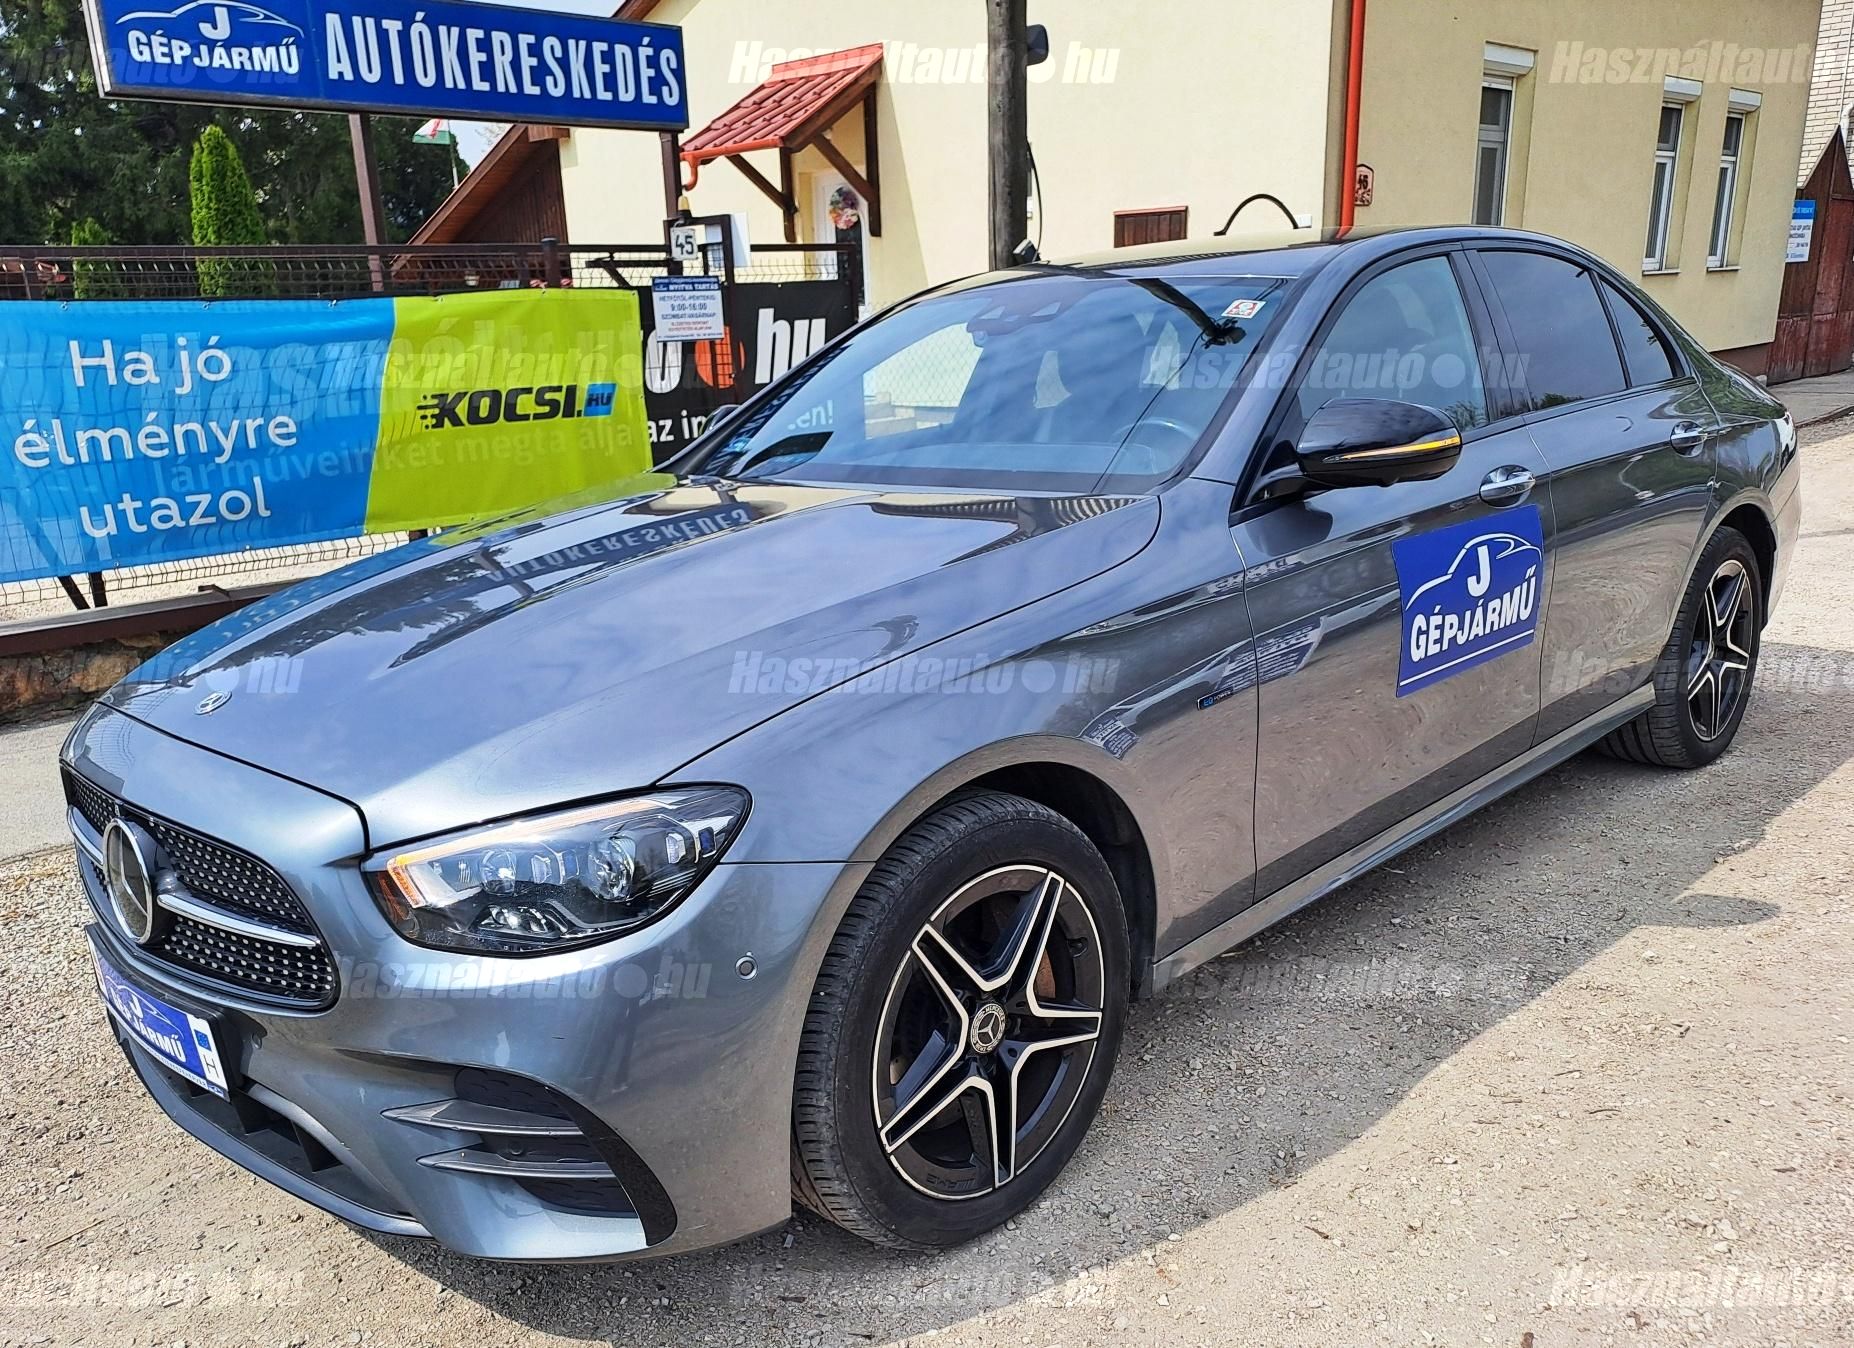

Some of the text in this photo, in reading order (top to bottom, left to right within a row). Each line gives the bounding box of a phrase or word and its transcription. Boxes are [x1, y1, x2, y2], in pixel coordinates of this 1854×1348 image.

[199, 6, 231, 40] J
[127, 29, 300, 75] GÉPJÁRMŰ
[326, 12, 680, 106] AUTÓKERESKEDÉS
[675, 234, 695, 255] 45
[69, 334, 232, 395] Ha jó
[13, 413, 298, 470] élményre
[80, 476, 271, 539] utazol
[1466, 544, 1491, 597] J
[1410, 564, 1536, 663] GÉPJÁRMŰ
